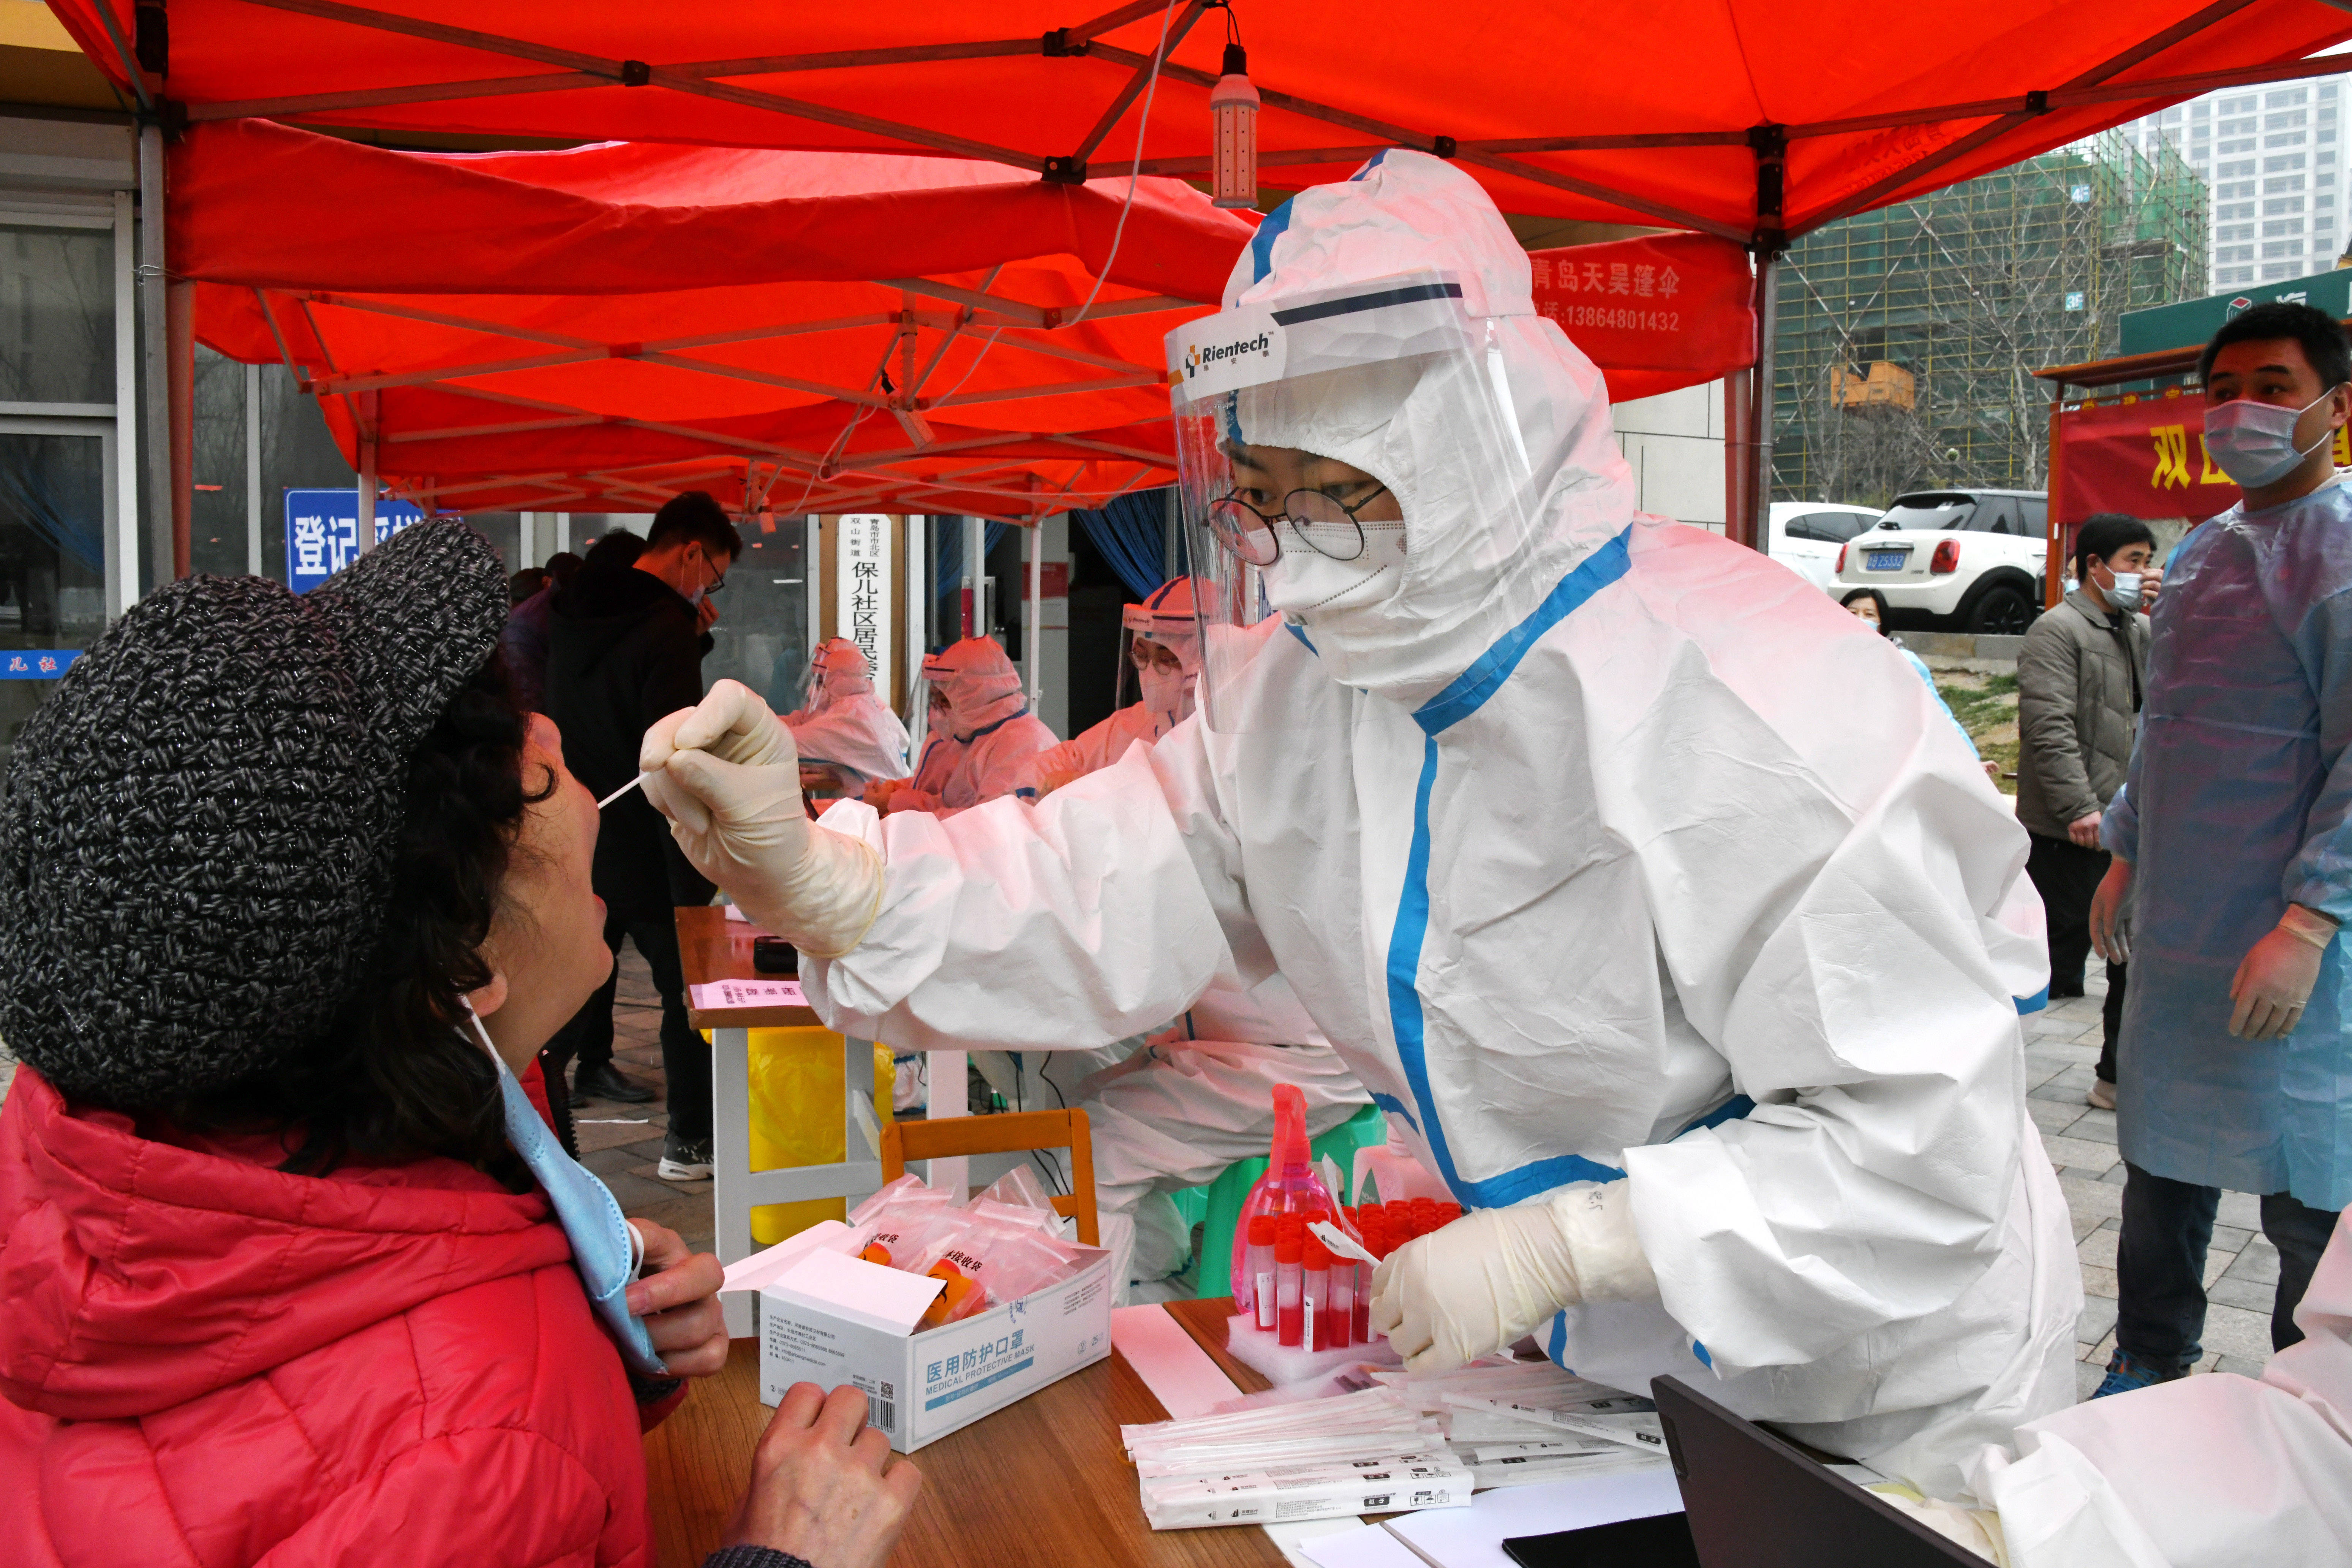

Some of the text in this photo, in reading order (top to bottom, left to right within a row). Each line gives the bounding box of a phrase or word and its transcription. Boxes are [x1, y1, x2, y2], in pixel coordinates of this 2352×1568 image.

[2072, 187, 2089, 201] 4F
[2067, 294, 2083, 308] 3F
[1203, 333, 1268, 364] Rientech
[850, 518, 861, 556] 双山街道
[869, 519, 880, 557] 青岛市市北区
[851, 561, 878, 680] 保儿社区居民
[926, 1375, 963, 1396] MEDICAL
[965, 1354, 1013, 1381] PROTECTIVE
[1014, 1344, 1035, 1360] MASK
[927, 1329, 1024, 1383] 医用防护口罩
